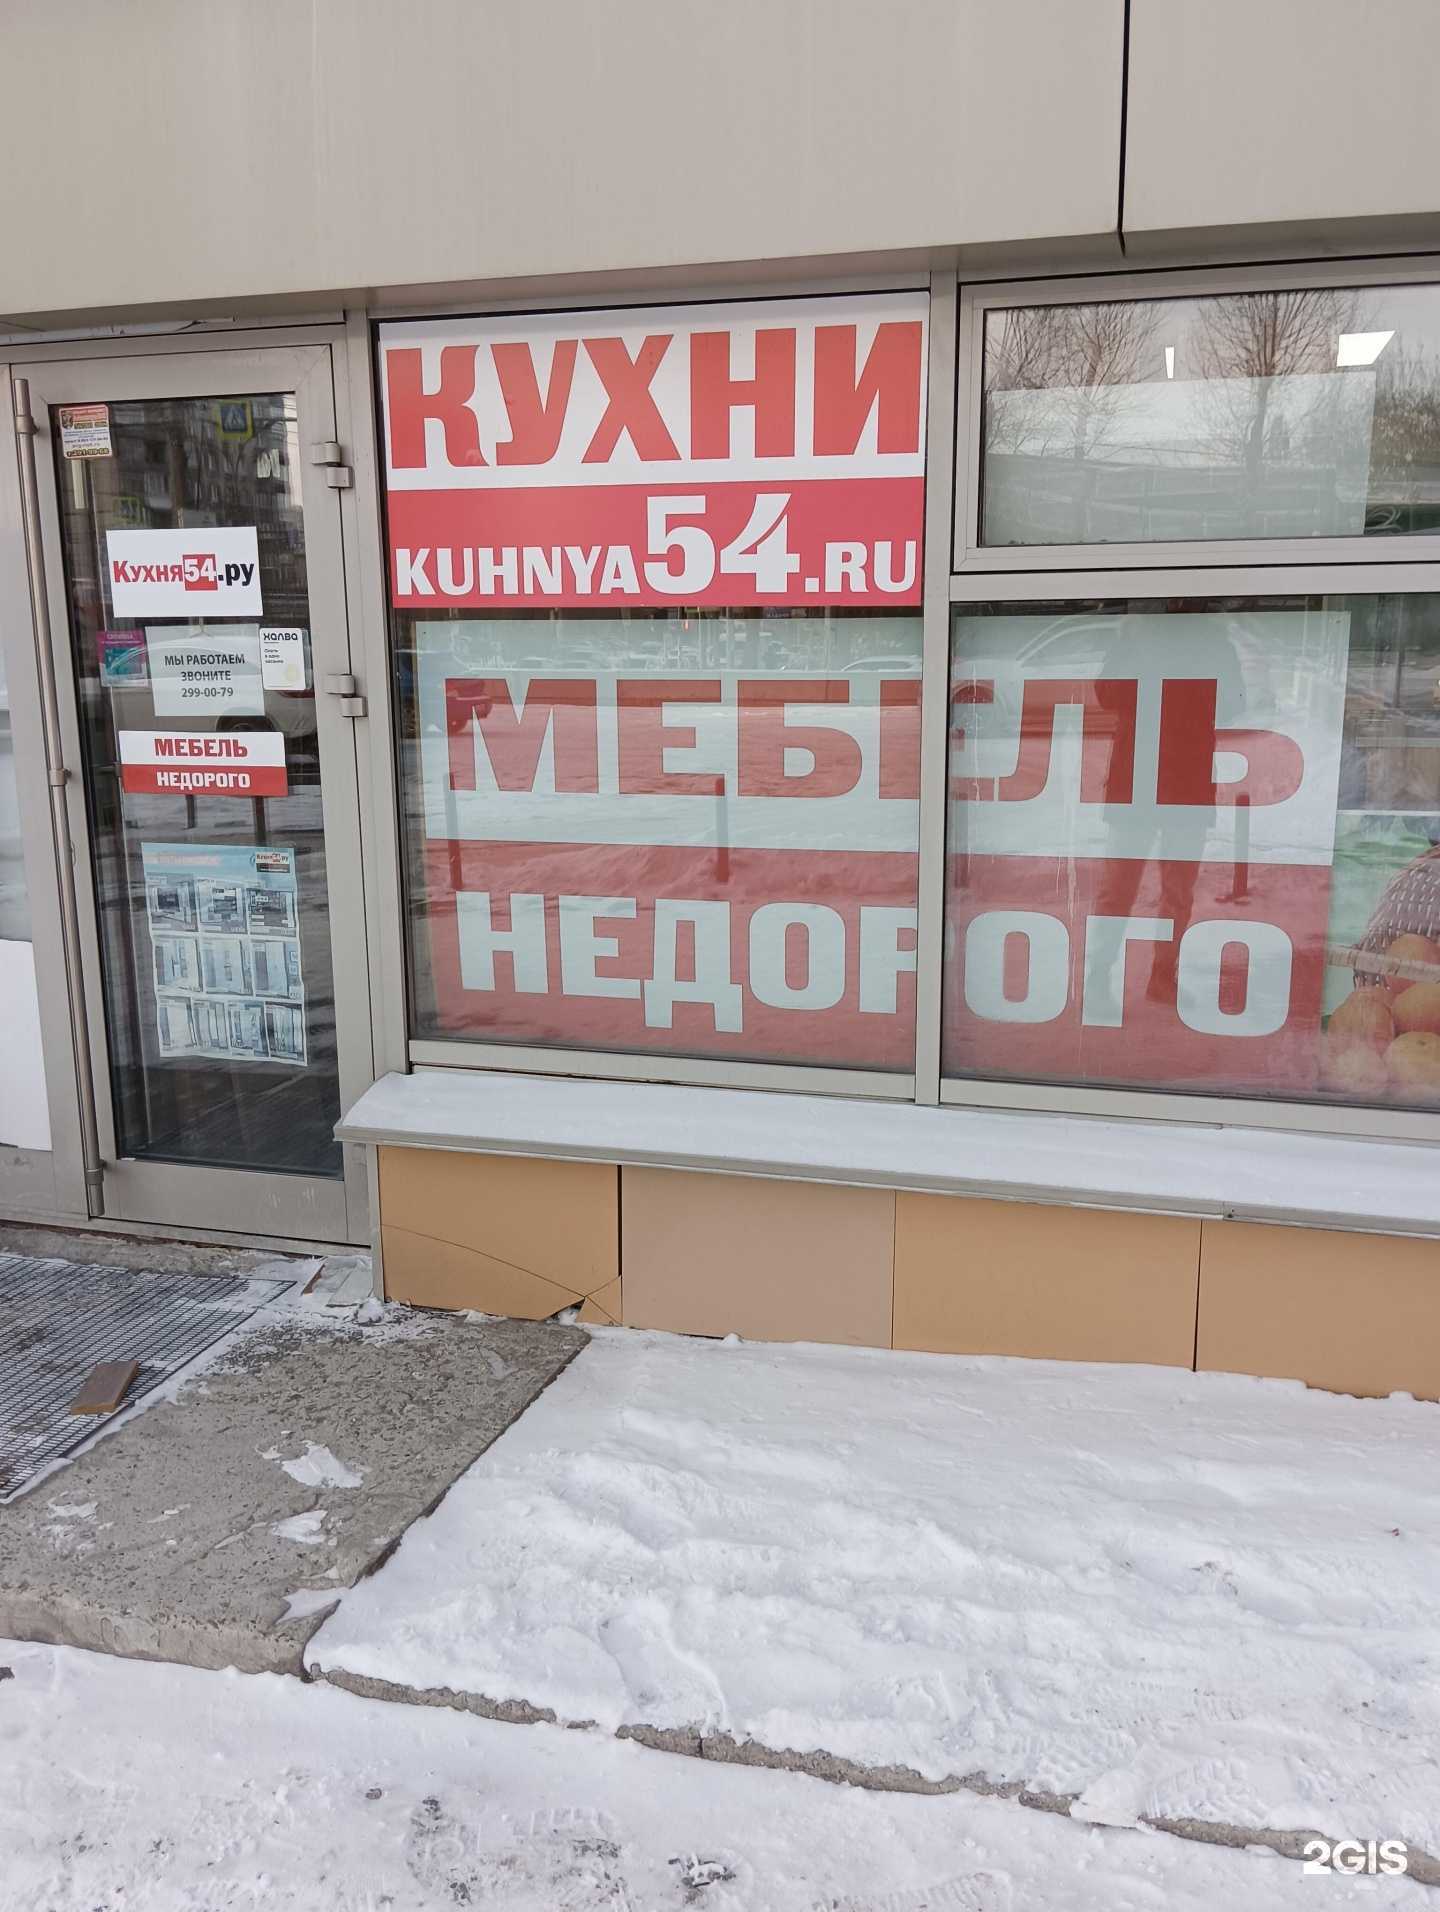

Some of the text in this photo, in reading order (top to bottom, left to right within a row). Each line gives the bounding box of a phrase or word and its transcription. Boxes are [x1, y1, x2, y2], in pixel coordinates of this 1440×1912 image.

[386, 320, 922, 469] КУХНИ
[396, 493, 916, 595] KUHNYA54.RU
[112, 557, 255, 586] Кухня54.ру
[164, 654, 245, 666] МЫ РАБОТАЕМ
[181, 670, 231, 682] ЗВОНИТЕ
[181, 686, 233, 698] 299-00-79
[154, 738, 248, 758] МЕБЕЛЬ
[445, 678, 1304, 807] МЕБЕЛЬ
[156, 771, 250, 790] НЕДОРОГО
[455, 890, 1293, 1037] НЕДОРОГО
